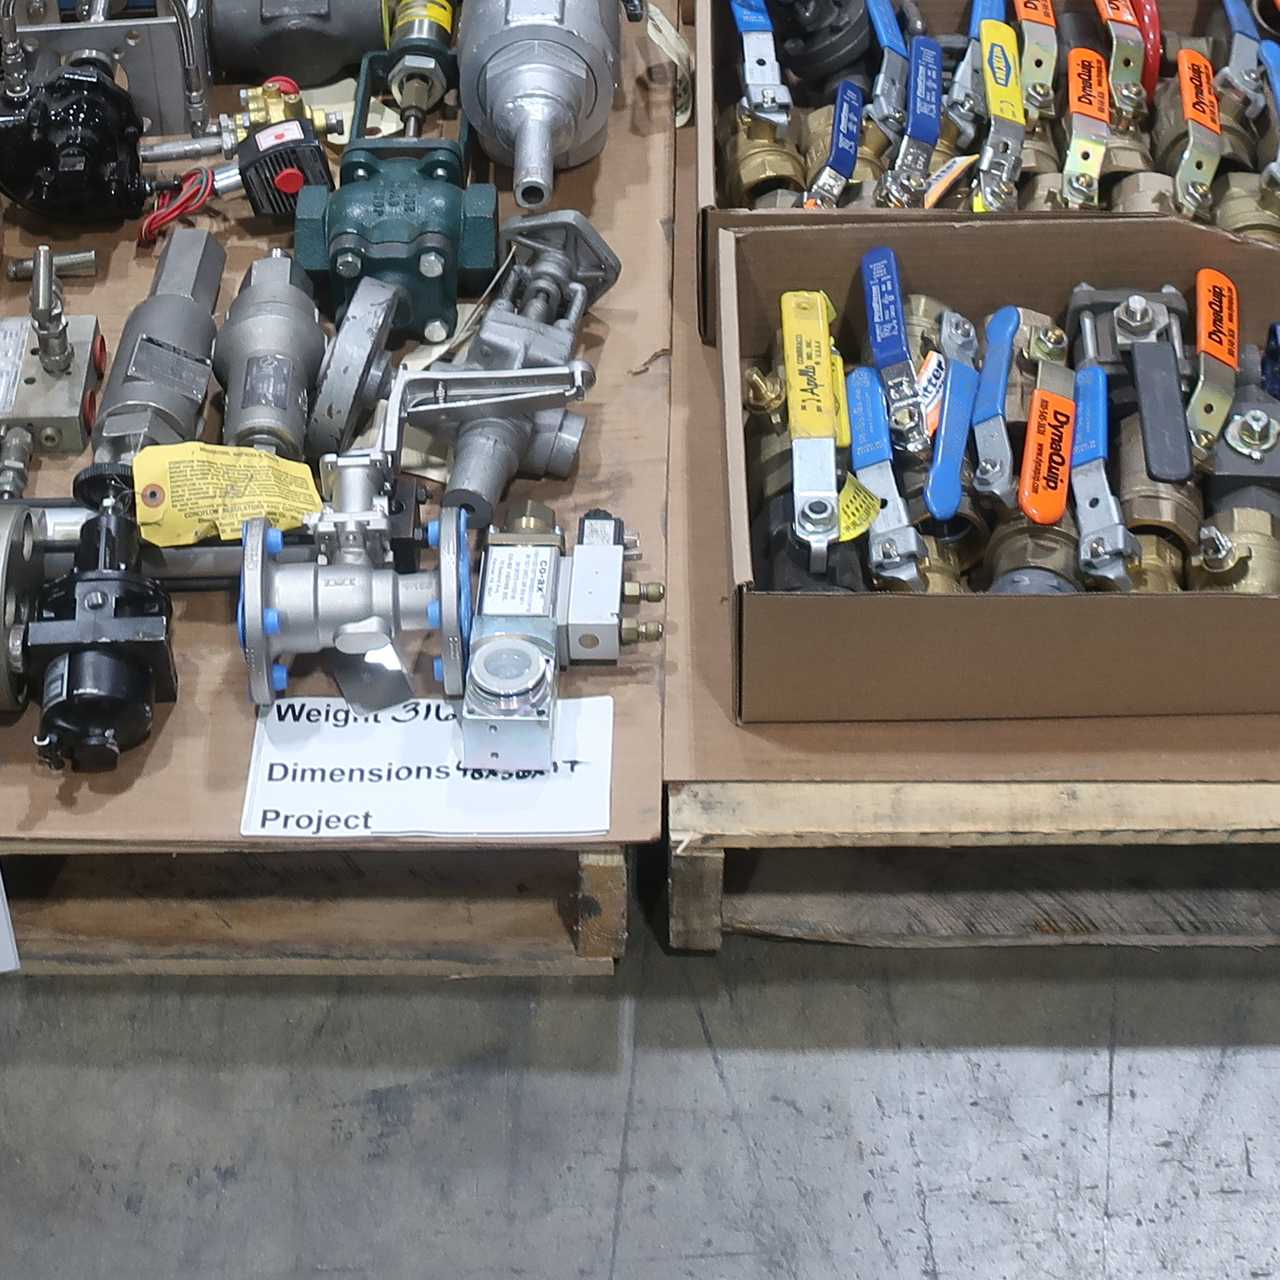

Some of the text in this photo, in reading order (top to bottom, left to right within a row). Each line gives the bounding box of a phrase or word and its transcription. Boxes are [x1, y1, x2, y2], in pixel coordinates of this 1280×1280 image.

[1077, 59, 1097, 106] DynaQuip
[1187, 62, 1206, 115] DynaQuip
[1207, 285, 1227, 347] DynaQuip
[798, 364, 823, 399] Apollo
[923, 359, 946, 401] itter
[1042, 409, 1070, 491] DynaQuip
[275, 701, 379, 728] Weig
[267, 762, 451, 784] Dimensions
[259, 808, 373, 836] Project
